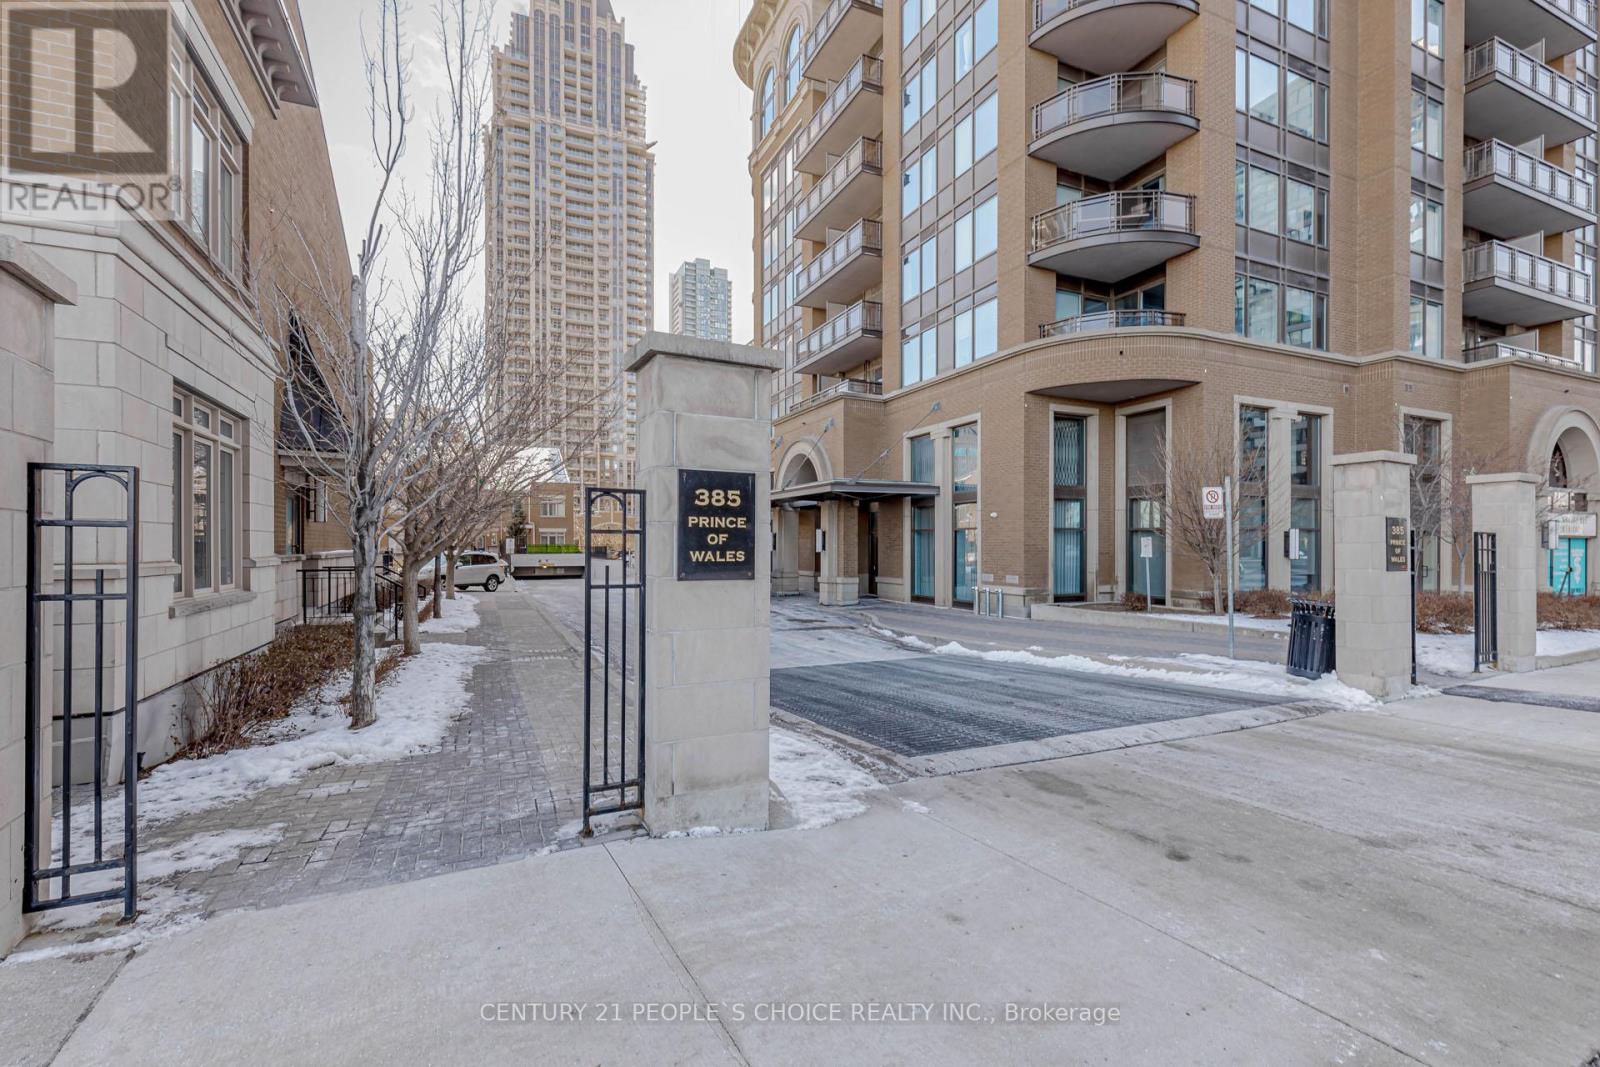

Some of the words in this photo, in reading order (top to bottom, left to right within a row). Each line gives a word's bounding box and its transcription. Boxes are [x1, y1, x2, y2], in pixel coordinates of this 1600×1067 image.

[695, 488, 741, 507] 385
[688, 516, 747, 528] PRINCE
[1391, 525, 1405, 535] 385
[707, 533, 729, 545] OF
[689, 550, 746, 562] WALES
